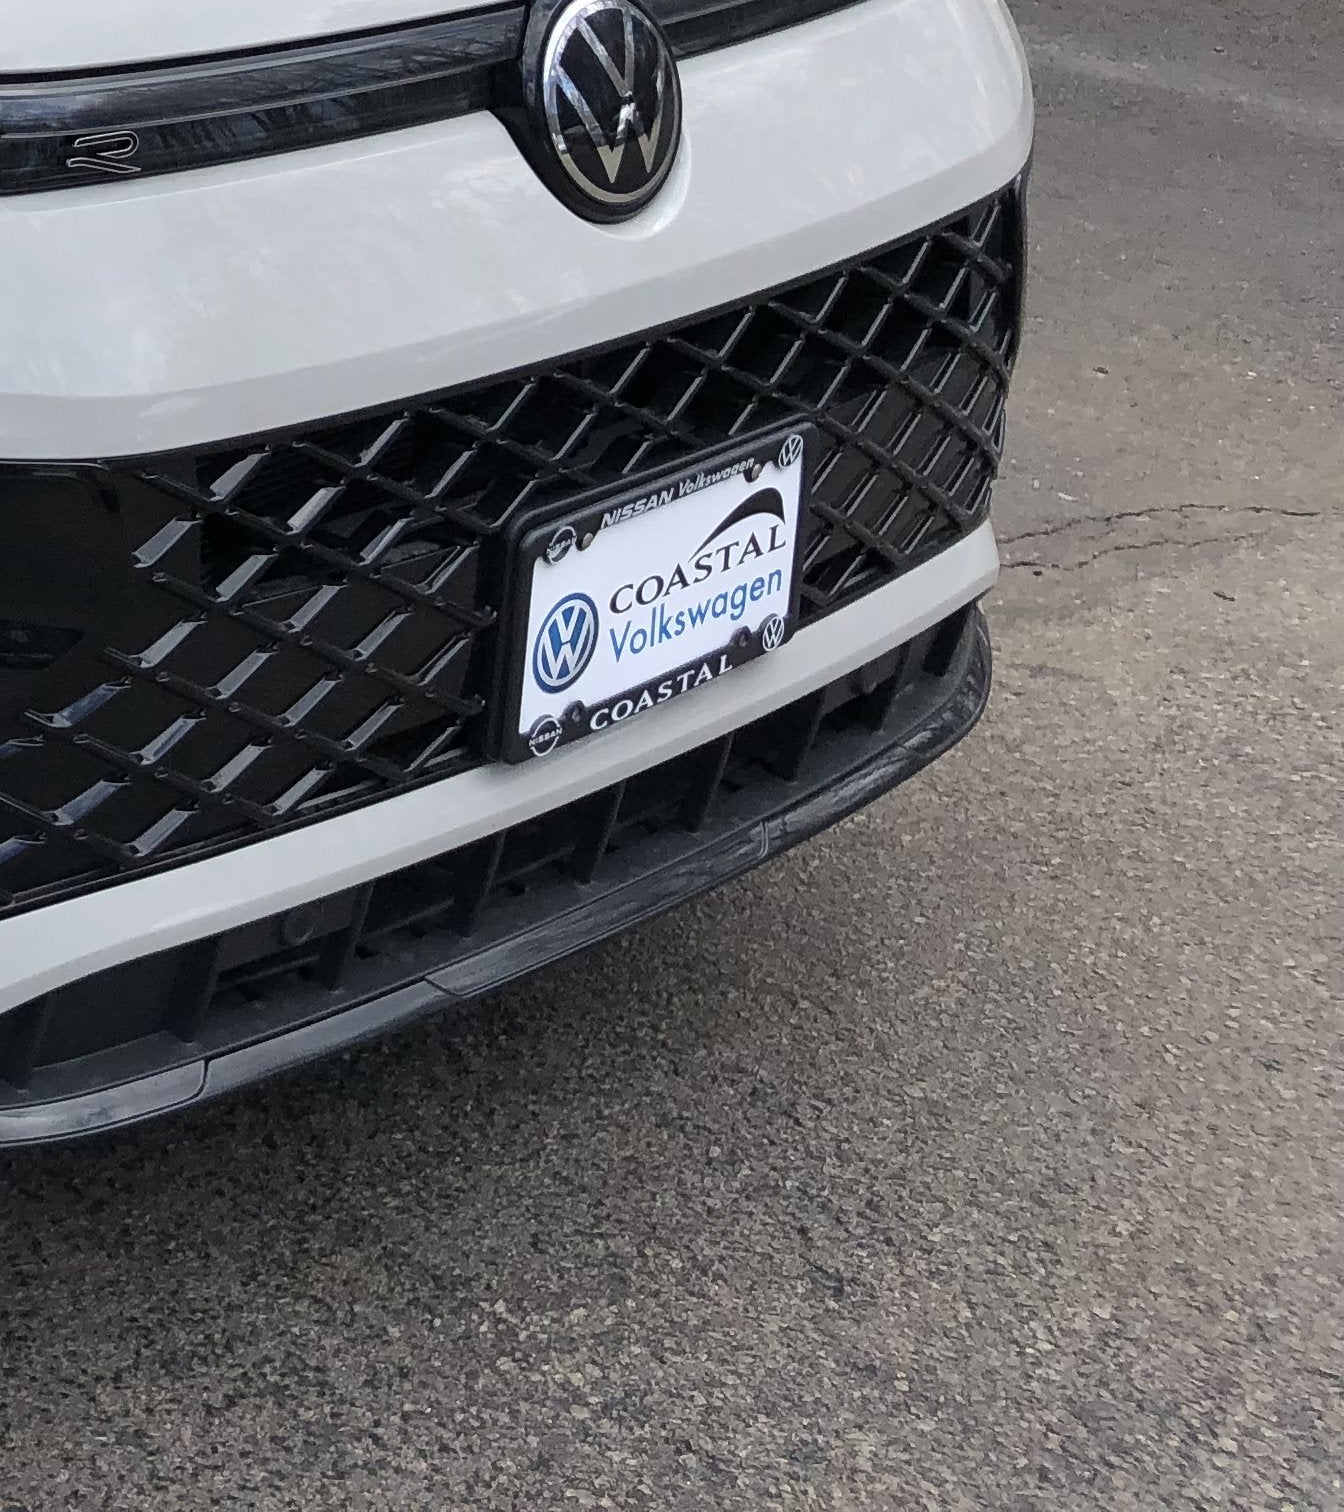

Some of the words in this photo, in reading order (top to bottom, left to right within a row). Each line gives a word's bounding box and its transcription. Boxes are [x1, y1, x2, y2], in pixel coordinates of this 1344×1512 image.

[601, 487, 674, 529] NISSAN
[679, 458, 755, 497] Volkswagen
[609, 525, 786, 614] COASTAL
[609, 568, 782, 663] Volkswagen
[590, 653, 733, 731] COASTAL
